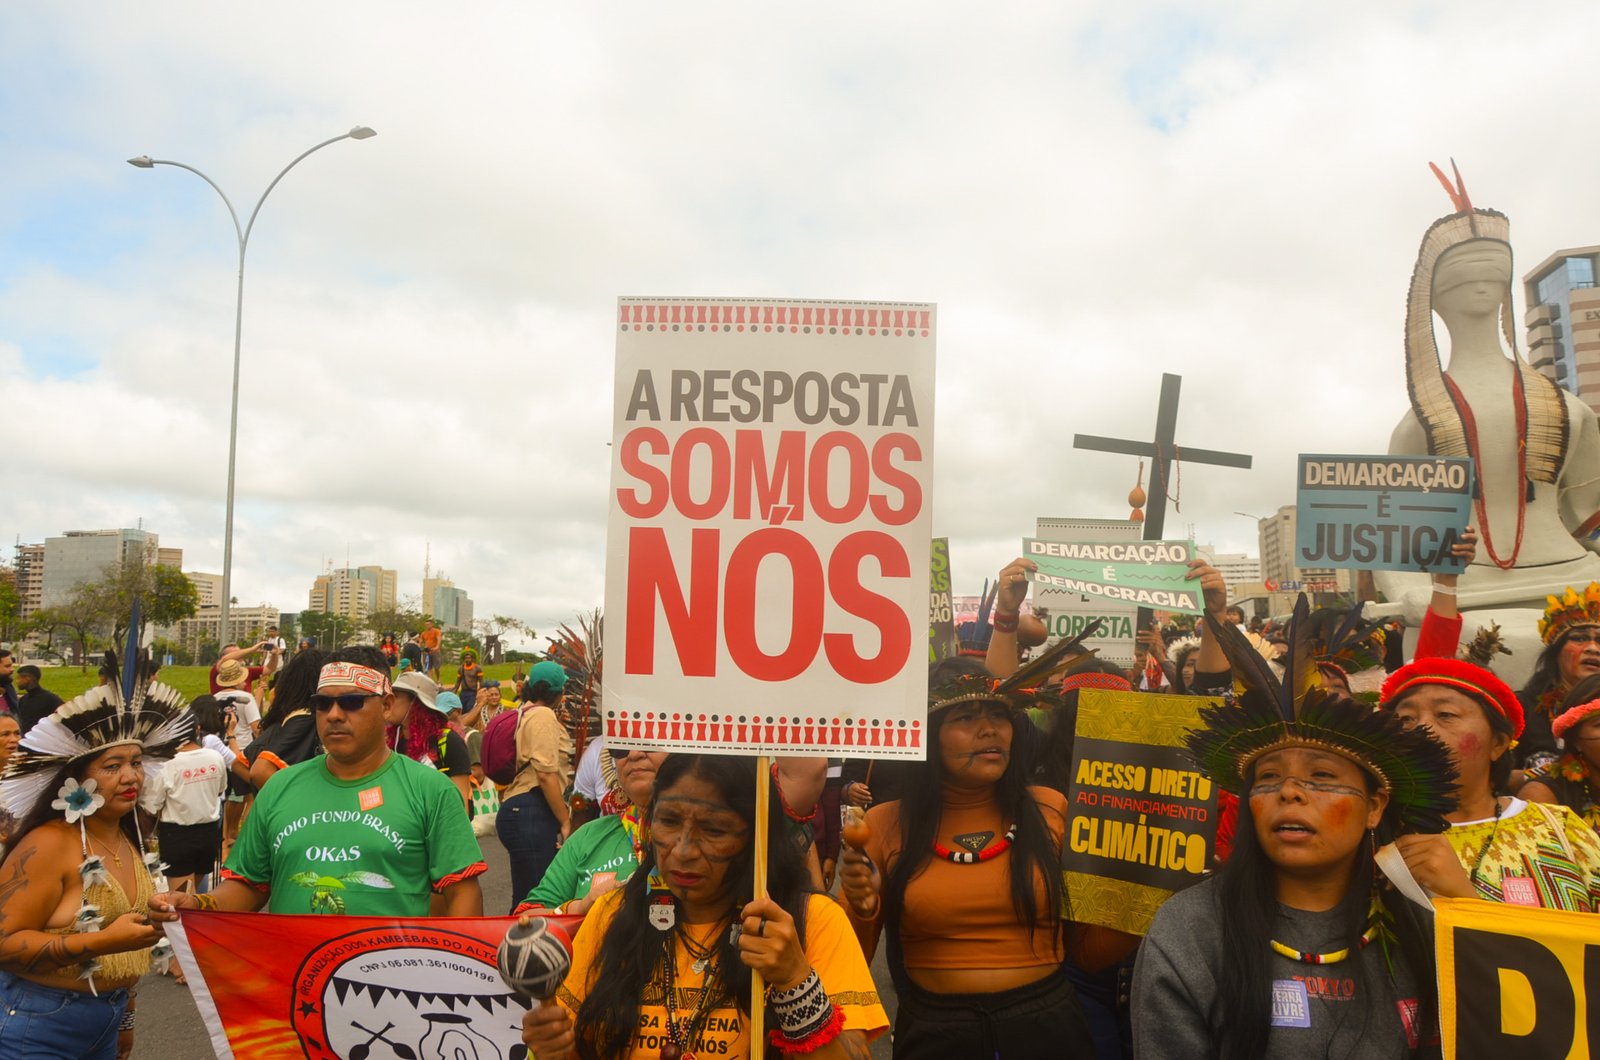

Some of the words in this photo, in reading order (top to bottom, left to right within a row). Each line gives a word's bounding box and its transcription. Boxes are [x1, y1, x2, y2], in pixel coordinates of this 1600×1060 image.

[625, 369, 661, 421] A
[670, 369, 919, 427] RESPOSTA
[616, 426, 923, 526] SOMOS
[1305, 459, 1465, 493] DEMARCAÇÃO
[1377, 491, 1391, 518] É
[1030, 541, 1187, 565] DEMARCAÇÃO
[1302, 523, 1459, 573] JUSTIÇA
[1103, 565, 1117, 581] É
[624, 505, 912, 684] NÓS
[1034, 572, 1196, 611] DEMOCRACIA
[1047, 614, 1133, 638] LORESTA
[1075, 758, 1146, 792] ACESSO
[1149, 767, 1212, 801] DIRETO
[1076, 791, 1098, 806] AO
[1101, 794, 1208, 822] FINANCIAMENTO
[311, 810, 361, 825] FUNDO
[362, 813, 406, 854] BRASIL
[1070, 814, 1206, 874] CLIMÁTICO
[305, 845, 361, 862] OKAS
[367, 935, 439, 946] KAMBEBAS
[442, 938, 462, 950] DO
[1272, 990, 1303, 1004] TERRA
[1272, 1003, 1305, 1018] LIVRE
[695, 1036, 728, 1054] NÓS
